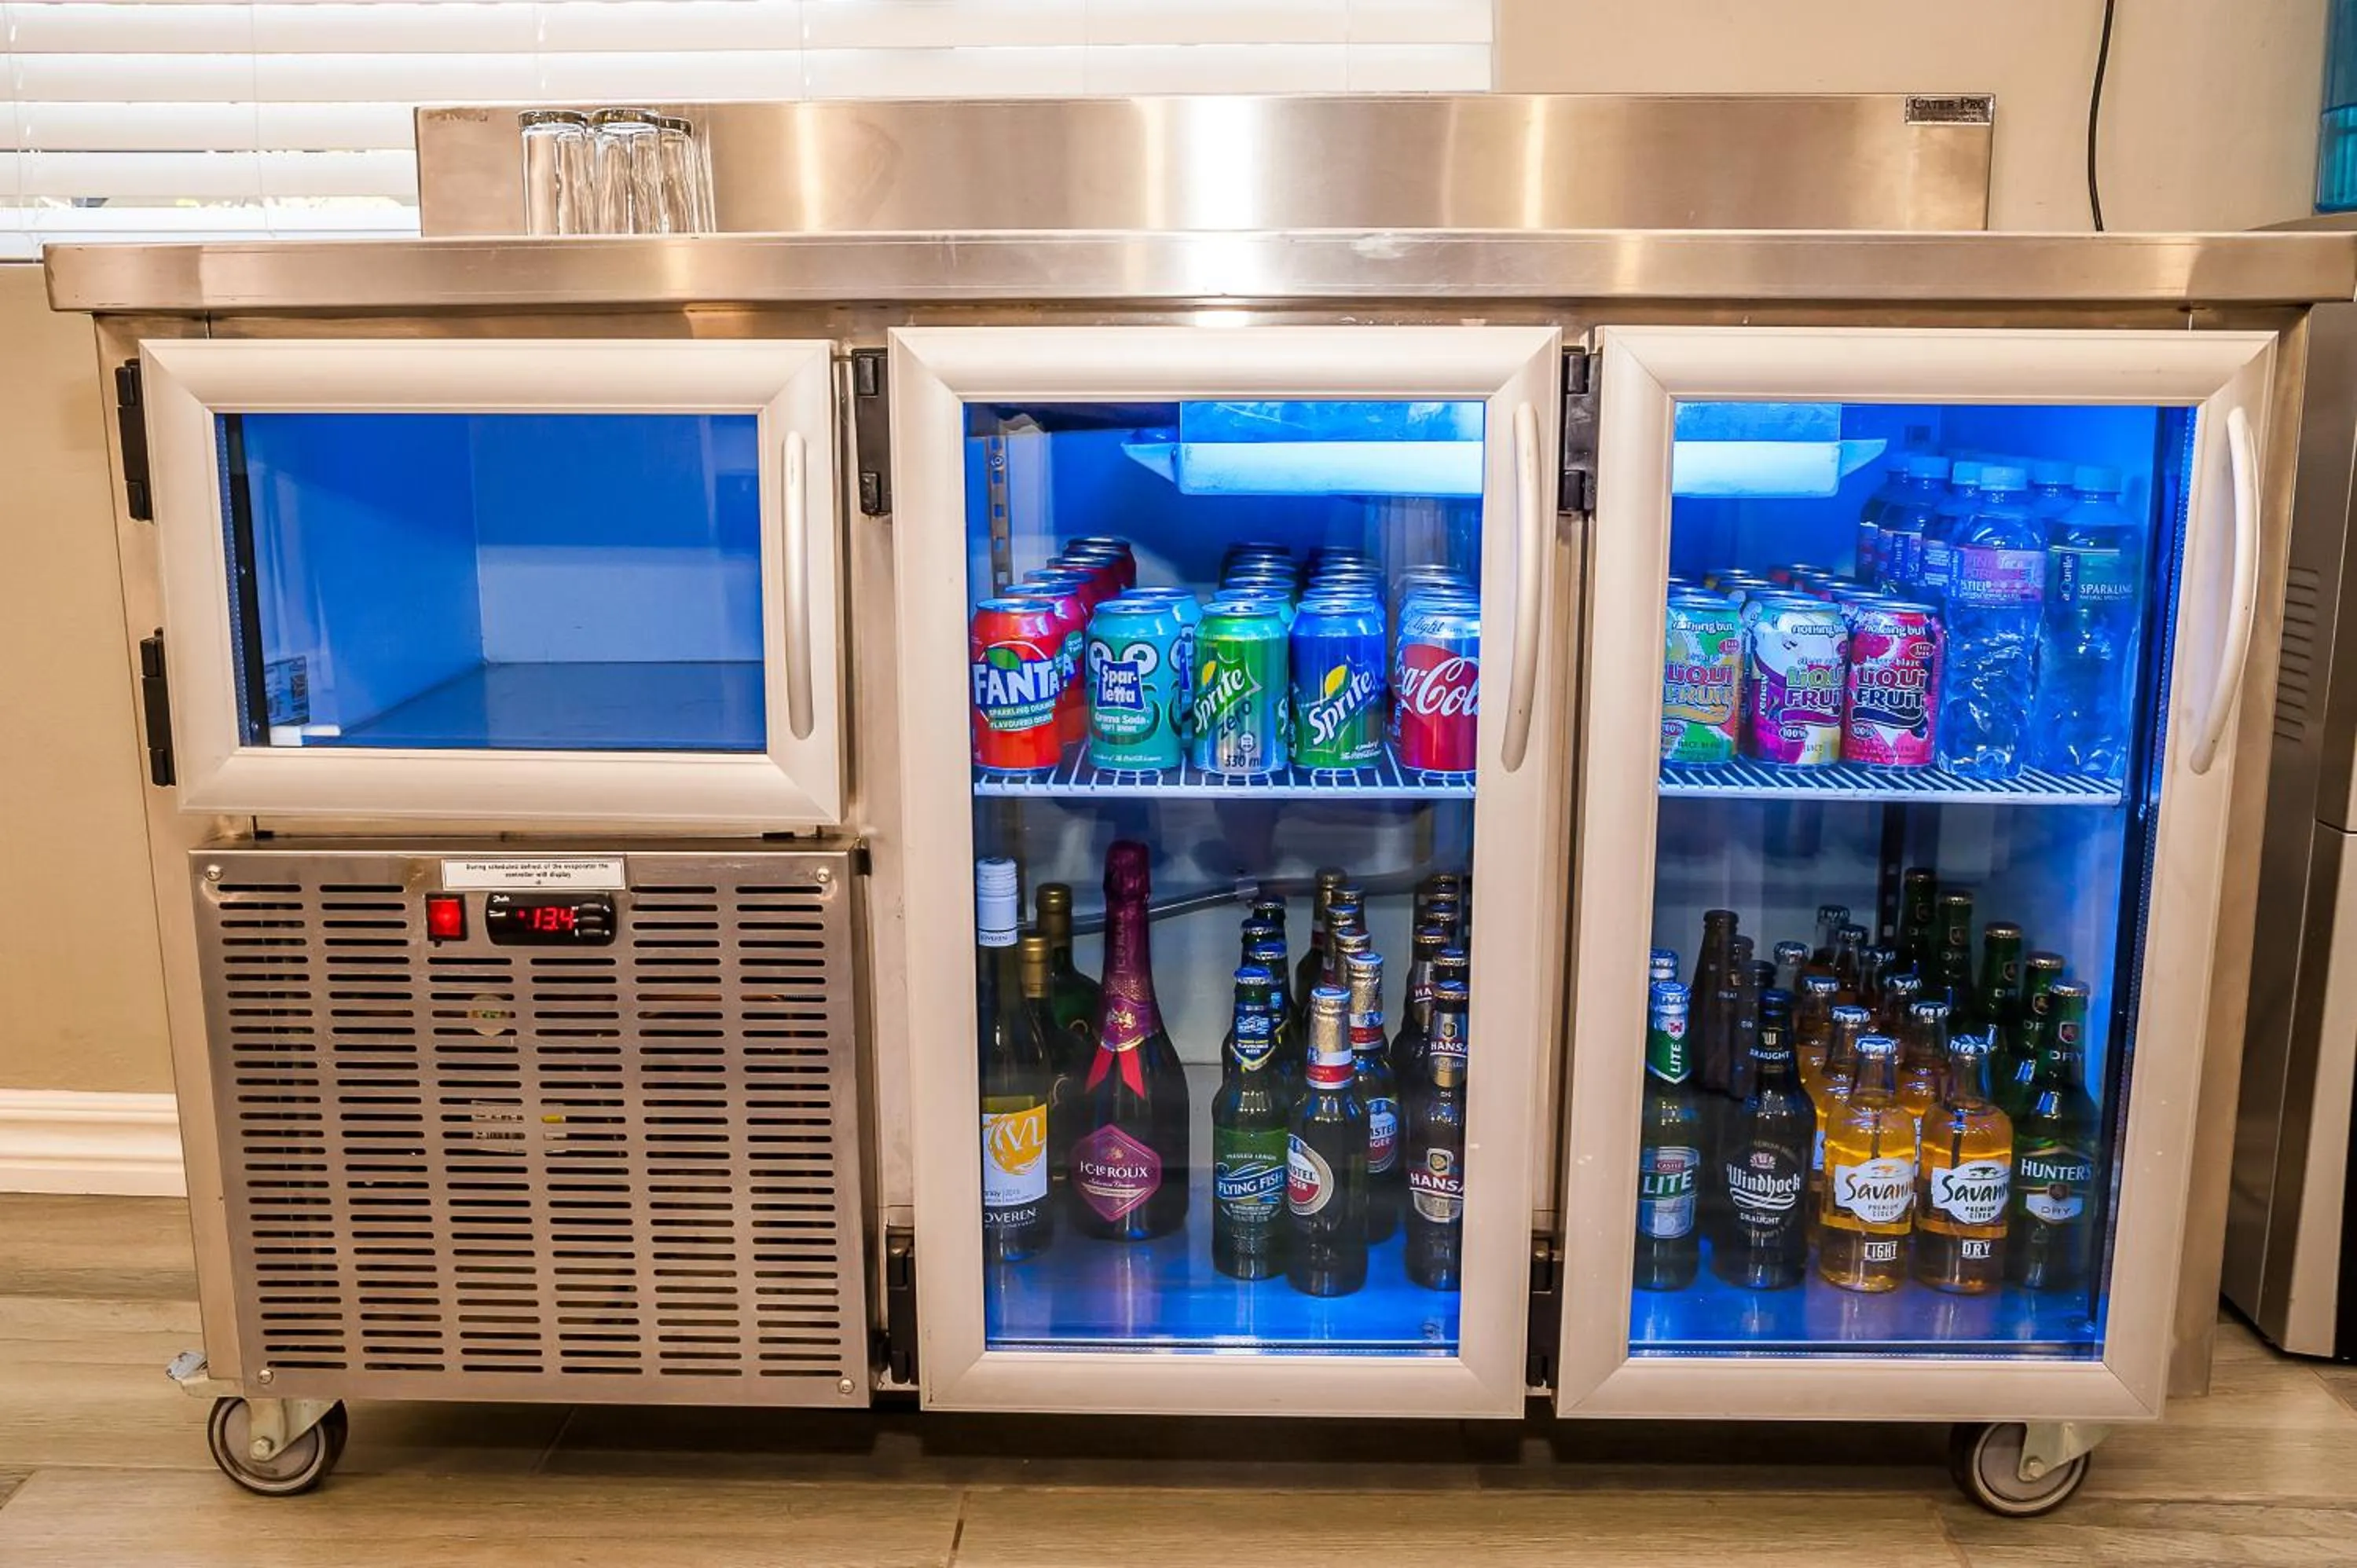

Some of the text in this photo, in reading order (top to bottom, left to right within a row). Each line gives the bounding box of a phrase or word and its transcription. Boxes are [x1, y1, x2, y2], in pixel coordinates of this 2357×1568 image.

[973, 661, 1059, 705] FANTA
[1193, 667, 1245, 733] Sprite
[1308, 669, 1375, 746] Sprite
[1225, 754, 1246, 768] 330
[1670, 1042, 1682, 1073] LITE
[1749, 1048, 1791, 1061] DRAUGHT
[2049, 1050, 2083, 1061] DRY
[1107, 1166, 1149, 1178] ROUX
[1726, 1163, 1801, 1196] Windhoek
[1219, 1171, 1284, 1195] FLYING FISH
[1643, 1169, 1694, 1195] LITE
[984, 1206, 1038, 1224] OVEREN
[1739, 1212, 1781, 1225] DRAUGHT
[2040, 1206, 2071, 1214] DRY
[1864, 1243, 1898, 1259] LIGHT
[1962, 1241, 1991, 1257] DRY
